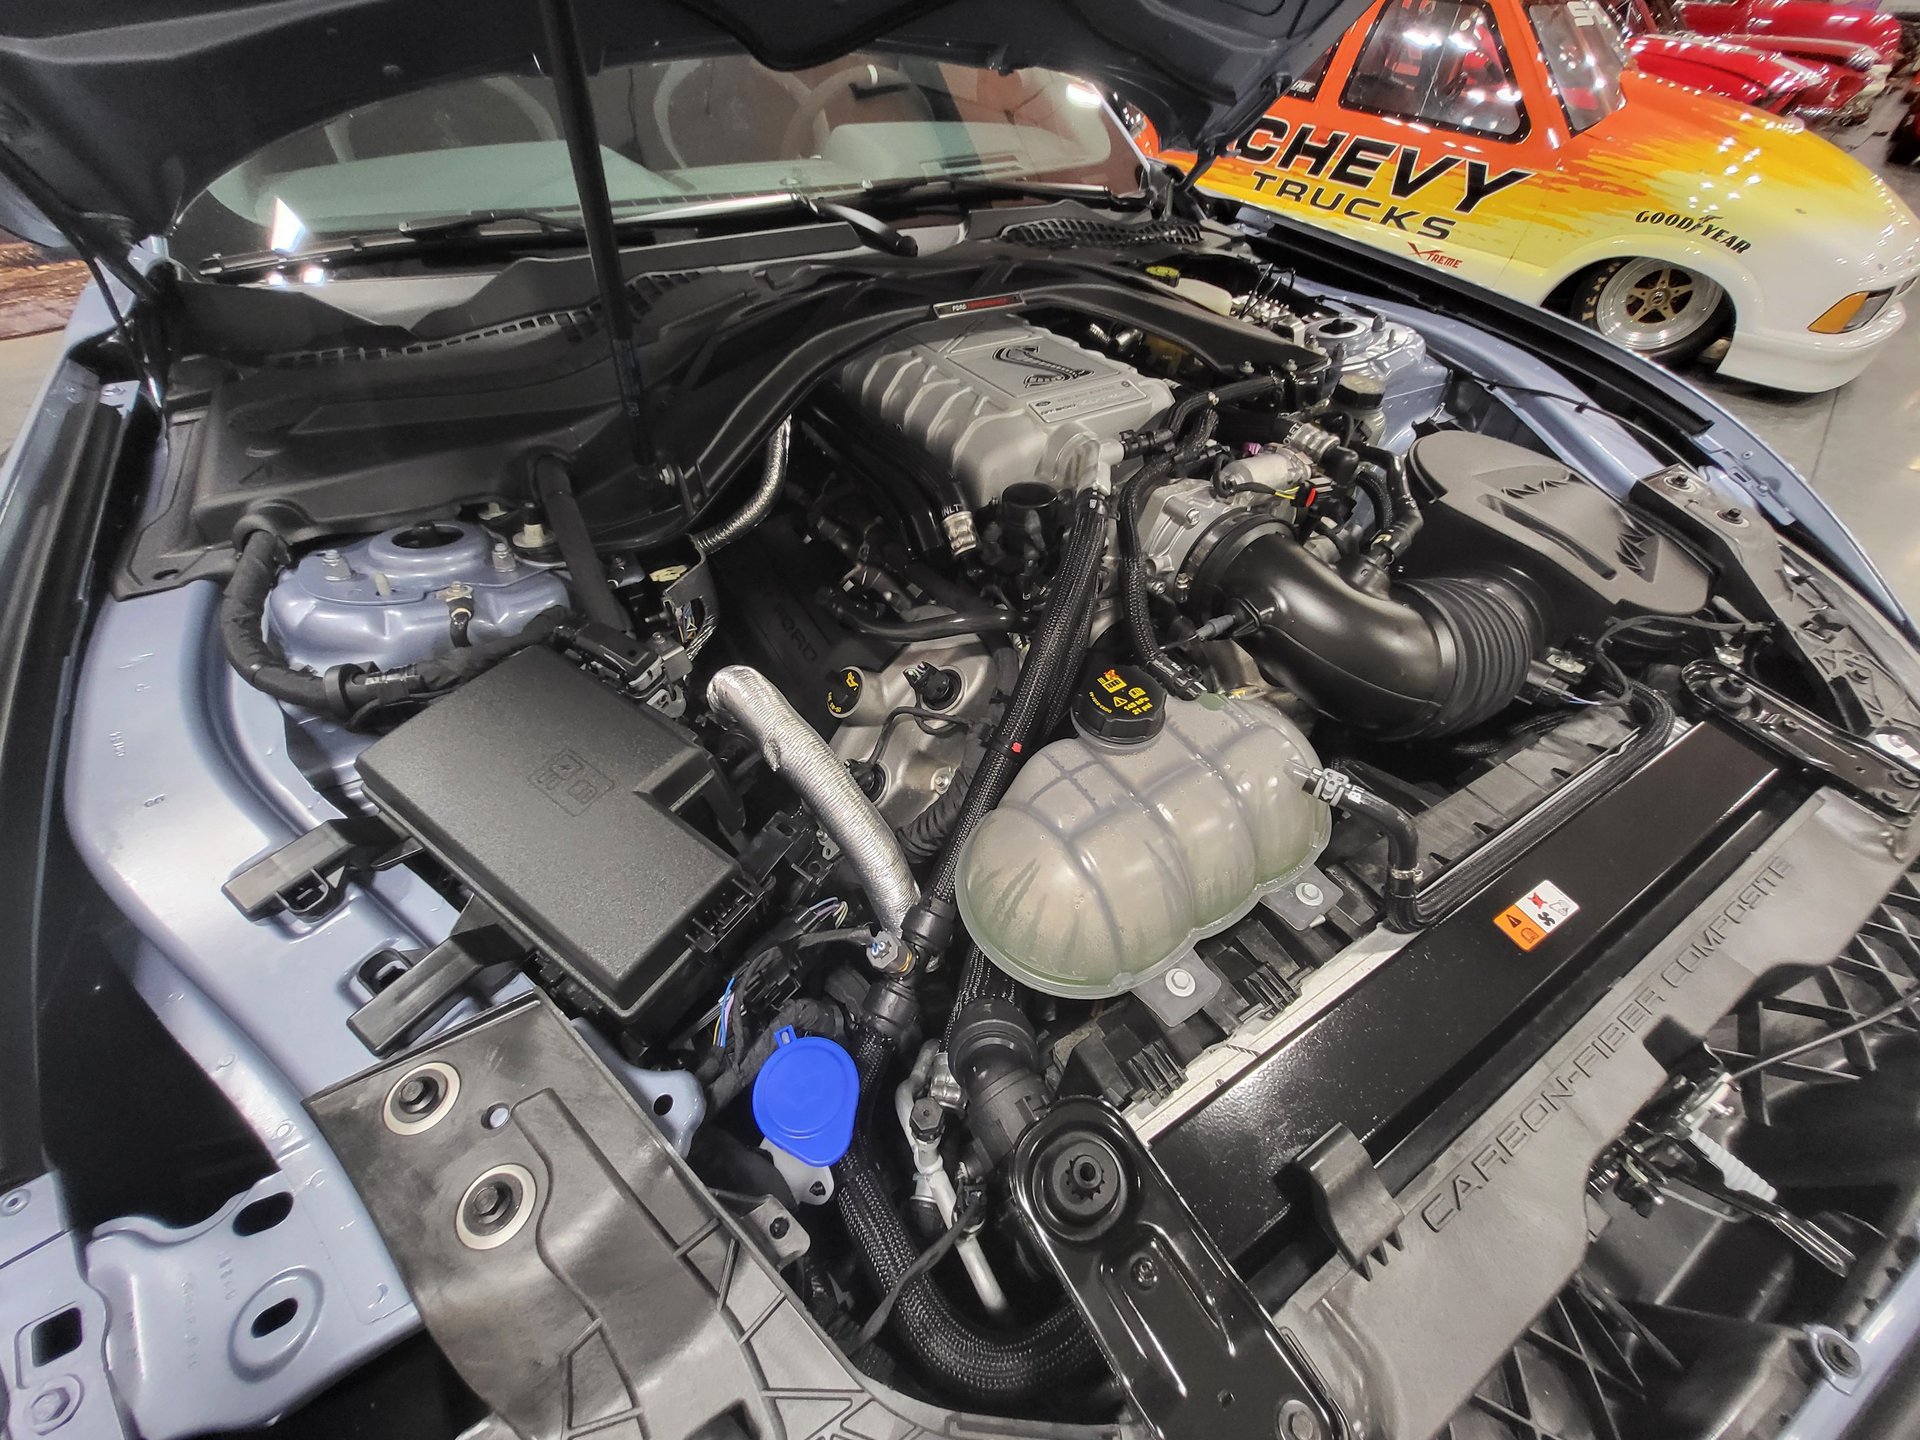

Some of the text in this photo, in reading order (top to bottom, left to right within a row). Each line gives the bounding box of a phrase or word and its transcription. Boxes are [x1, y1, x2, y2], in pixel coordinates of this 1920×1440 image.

[1235, 115, 1538, 215] CHEVY
[1251, 170, 1457, 241] TRUCKS
[1635, 210, 1752, 255] GOODYEAR
[1660, 855, 1793, 989] COMPOSITE
